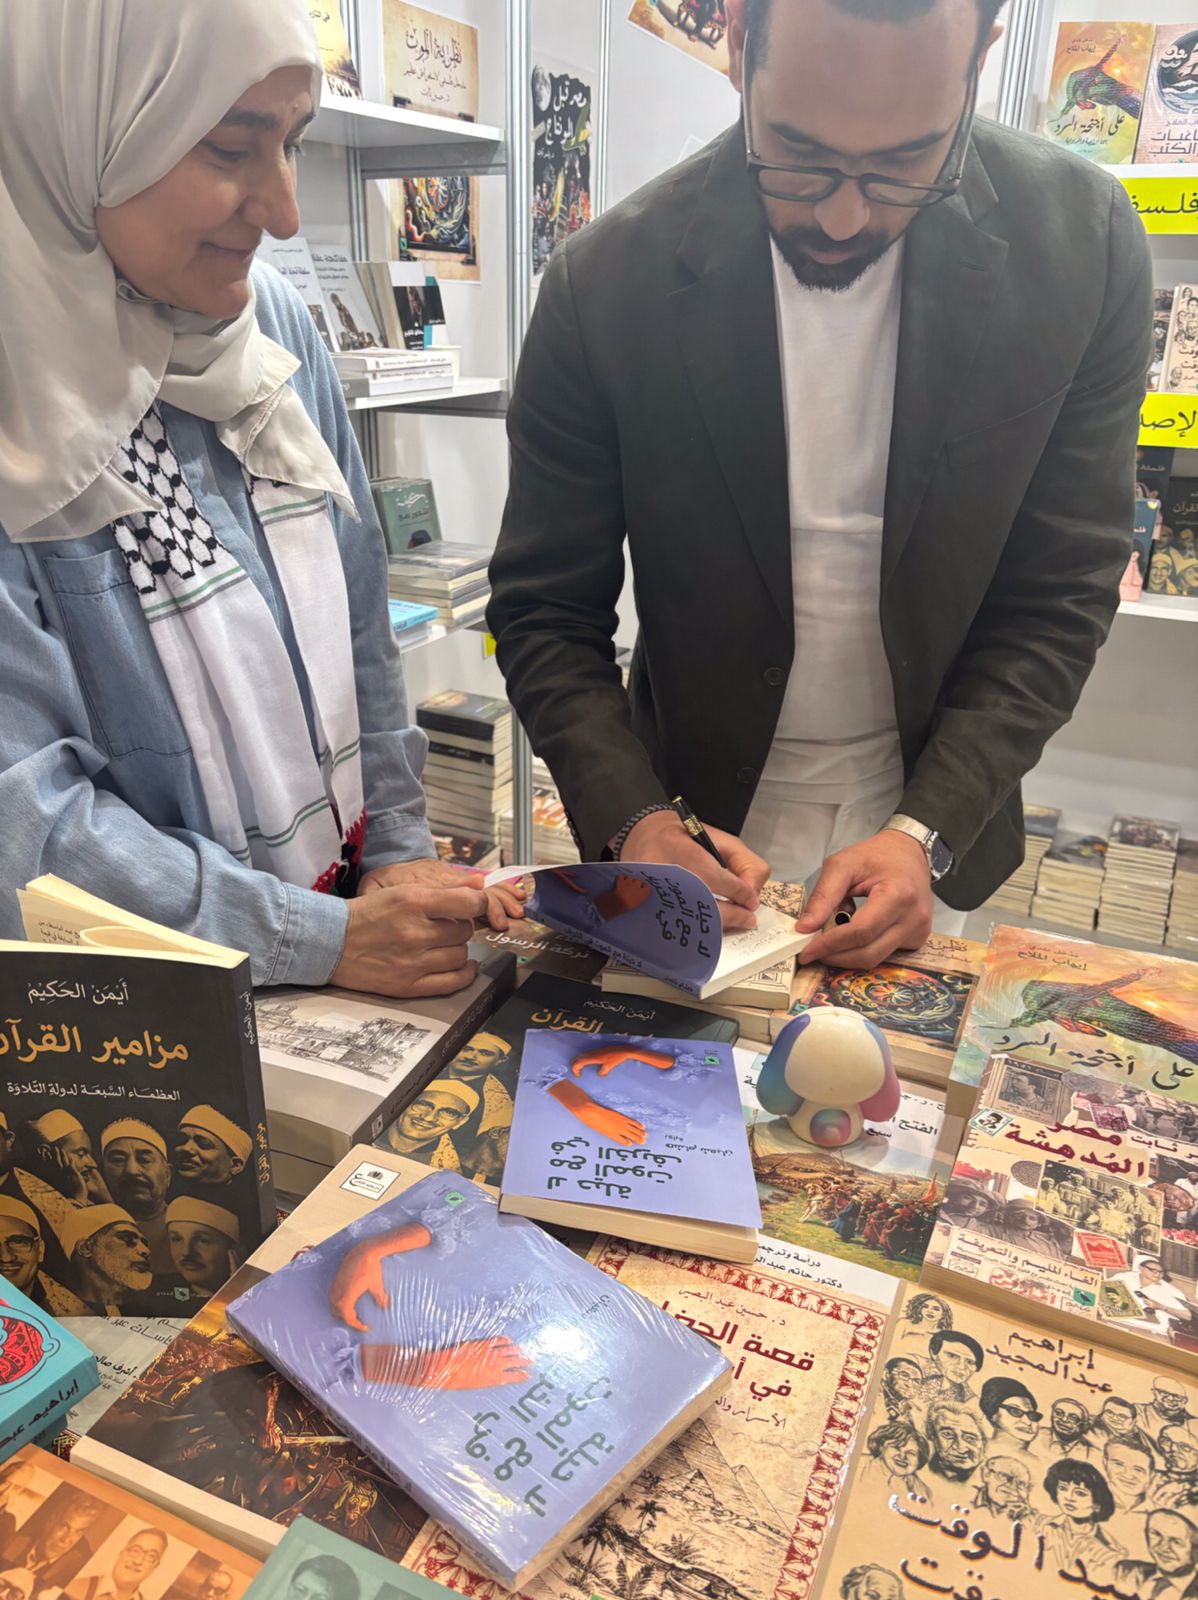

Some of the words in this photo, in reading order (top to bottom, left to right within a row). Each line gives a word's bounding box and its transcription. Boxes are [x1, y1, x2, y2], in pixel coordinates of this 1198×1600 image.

[553, 80, 570, 112] قبل
[569, 91, 587, 108] مصر
[664, 876, 694, 918] الموت
[655, 912, 678, 941] في
[697, 900, 712, 935] حيلة
[485, 931, 548, 951] الرسول
[676, 917, 689, 948] مع
[549, 938, 589, 960] تركة
[697, 940, 711, 959] لا
[1017, 950, 1048, 962] الملاح
[1052, 956, 1088, 971] إيهاب
[530, 1006, 603, 1034] القرآن
[91, 1030, 190, 1070] مزامير
[993, 1031, 1058, 1057] السرد
[1068, 1049, 1136, 1076] أجنحة
[1151, 1062, 1195, 1091] على
[897, 1118, 939, 1137] الفتح
[1045, 1119, 1123, 1146] مصر
[550, 1136, 590, 1155] في
[598, 1146, 682, 1168] الخريف
[665, 1143, 698, 1153] هشام
[700, 1147, 734, 1157] شعبان
[1130, 1134, 1179, 1152] ثابت
[549, 1155, 587, 1170] مع
[595, 1162, 673, 1184] الموت
[546, 1176, 568, 1190] لا
[576, 1177, 632, 1199] حيلة
[766, 1259, 787, 1272] عبد
[787, 1265, 813, 1279] حاتم
[793, 1252, 822, 1268] دراسة
[814, 1275, 843, 1289] دكتور
[678, 1287, 713, 1303] البصير
[715, 1296, 735, 1308] عبد
[735, 1303, 768, 1320] حسين
[742, 1333, 815, 1372] قصة
[1007, 1328, 1095, 1370] إبراهيم
[112, 1361, 135, 1377] أشرف
[985, 1343, 1070, 1380] المجيد
[749, 1379, 793, 1402] في
[1072, 1371, 1114, 1395] عبد
[732, 1406, 787, 1430] الأسرار
[464, 1410, 501, 1463] في
[493, 1436, 534, 1482] مع
[522, 1483, 548, 1519] لا
[549, 1431, 616, 1482] حيلة
[886, 1491, 1047, 1572] الوقت
